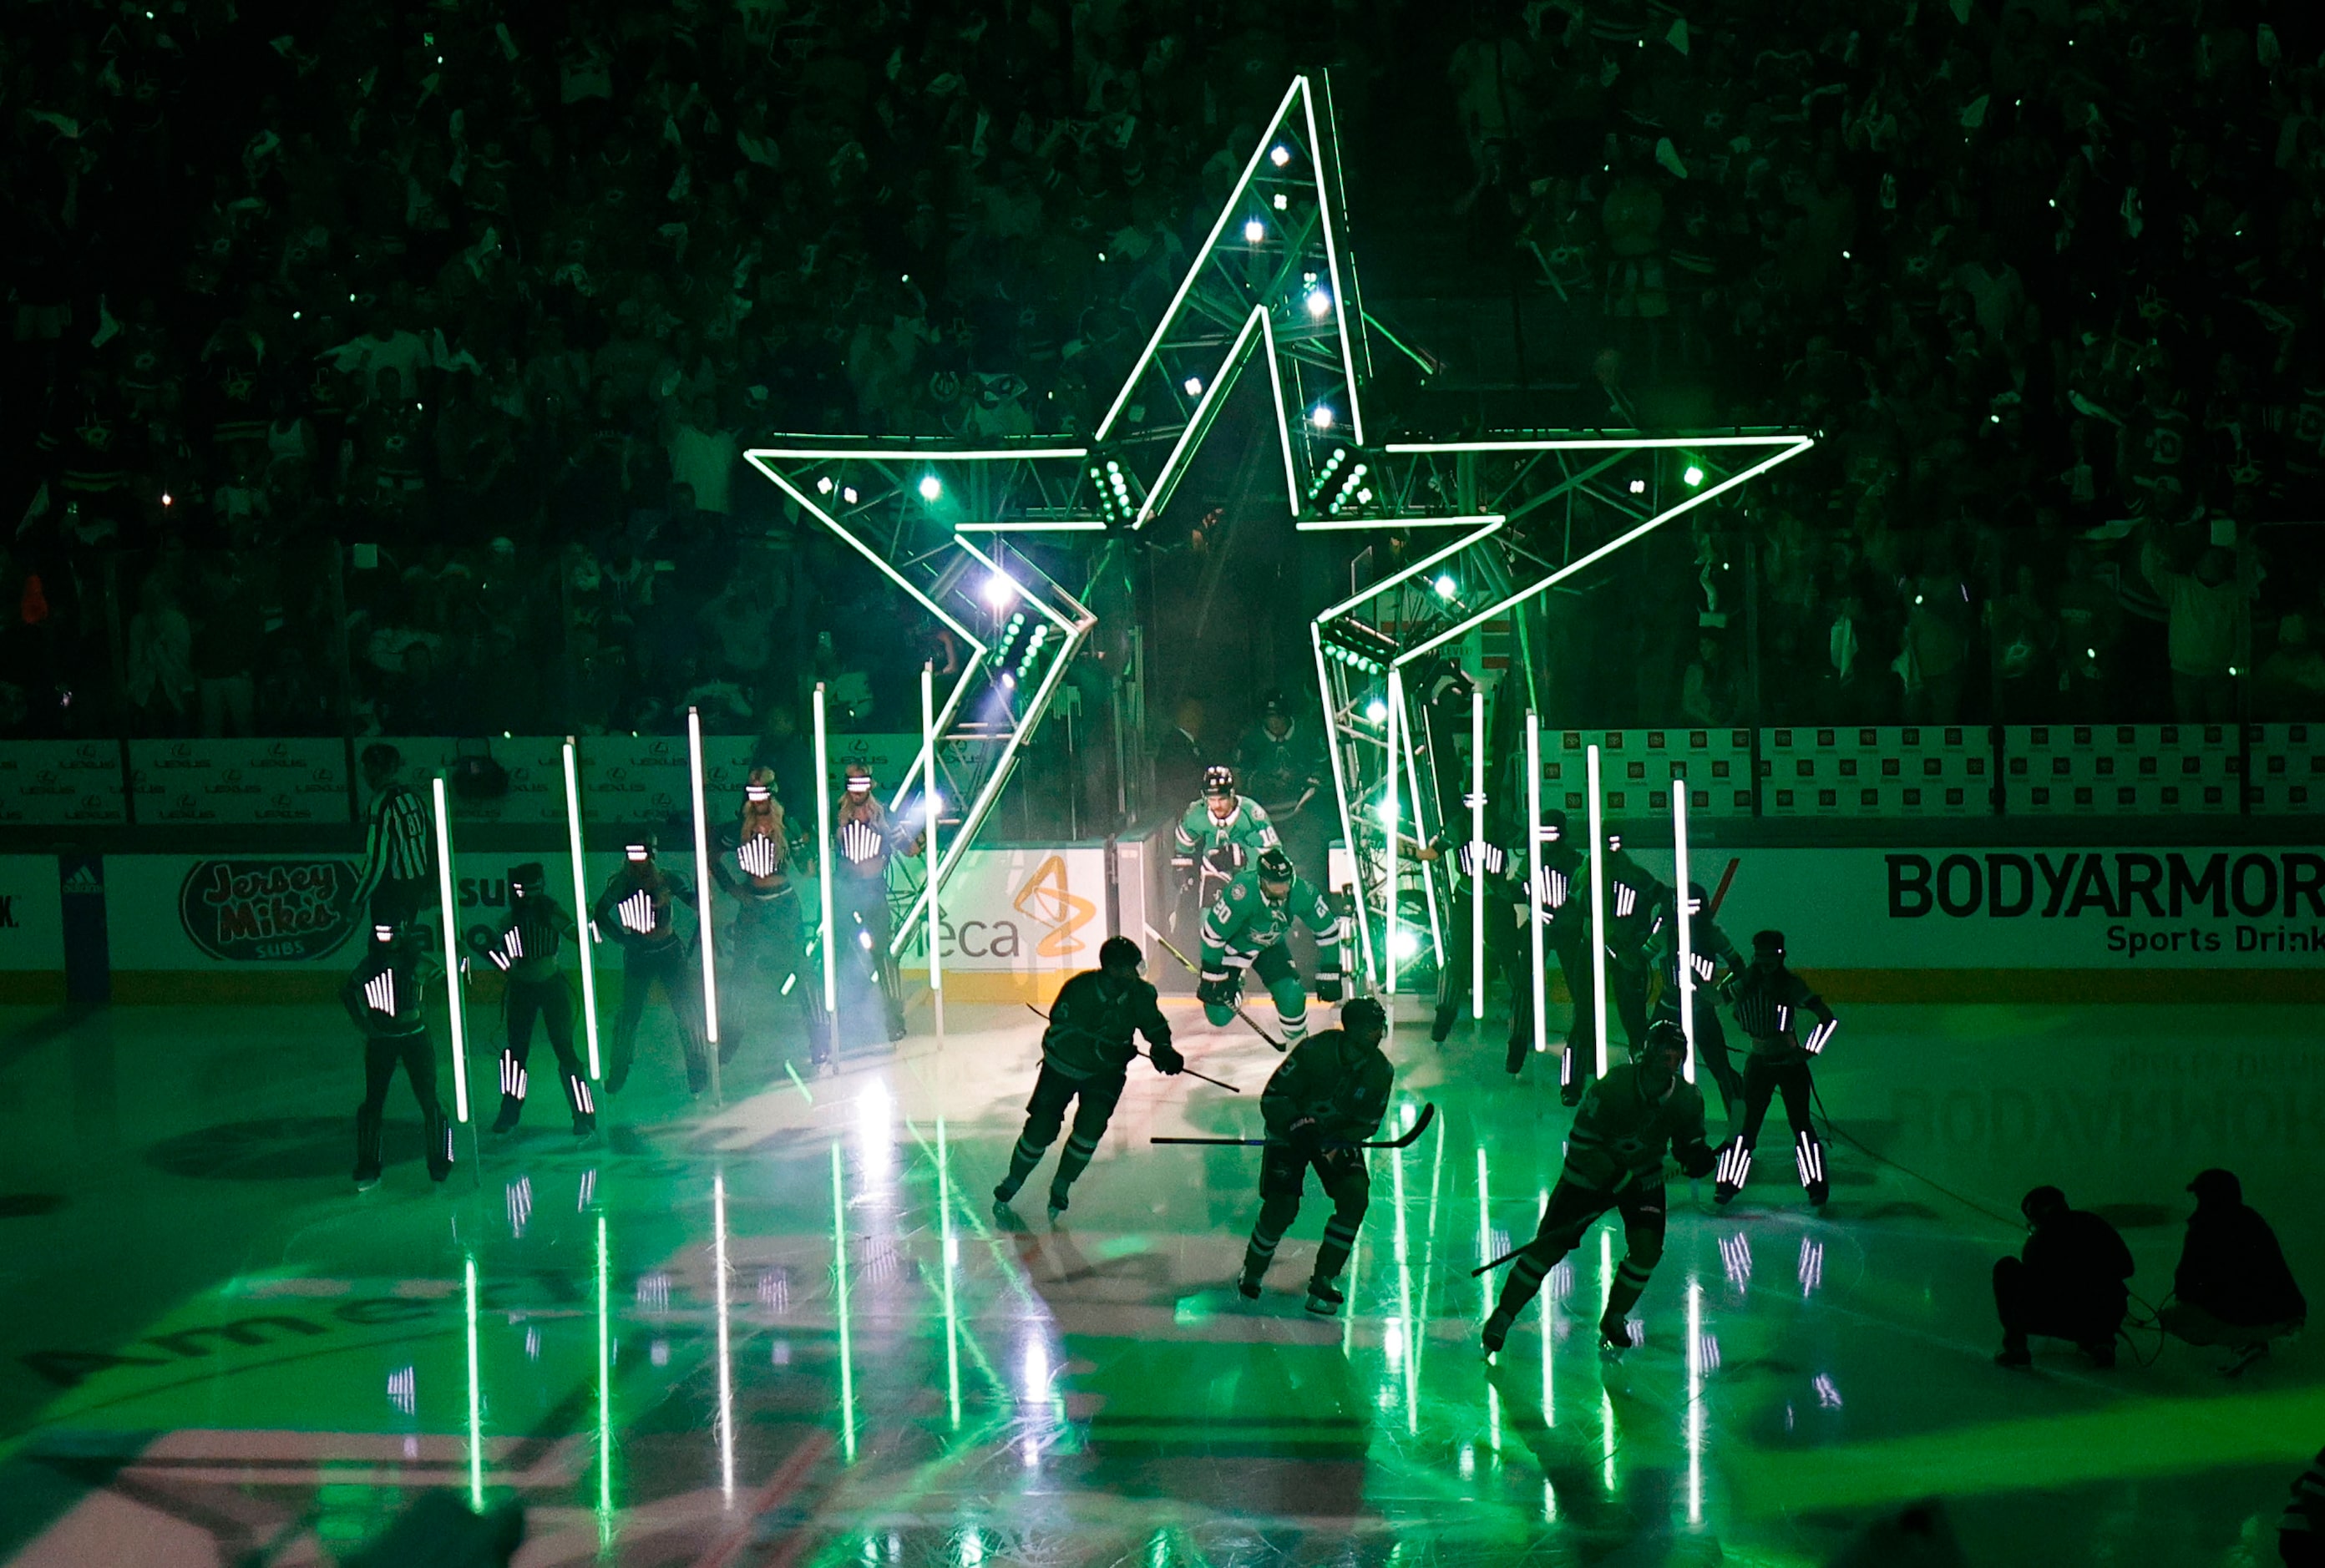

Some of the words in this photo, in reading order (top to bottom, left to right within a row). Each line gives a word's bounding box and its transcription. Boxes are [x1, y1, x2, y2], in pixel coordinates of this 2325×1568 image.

[831, 755, 888, 766] LEXUS
[203, 862, 339, 906] Jersey
[1884, 852, 2325, 918] BODYARMOR
[217, 893, 341, 943] Mike's
[2106, 925, 2221, 958] Sports
